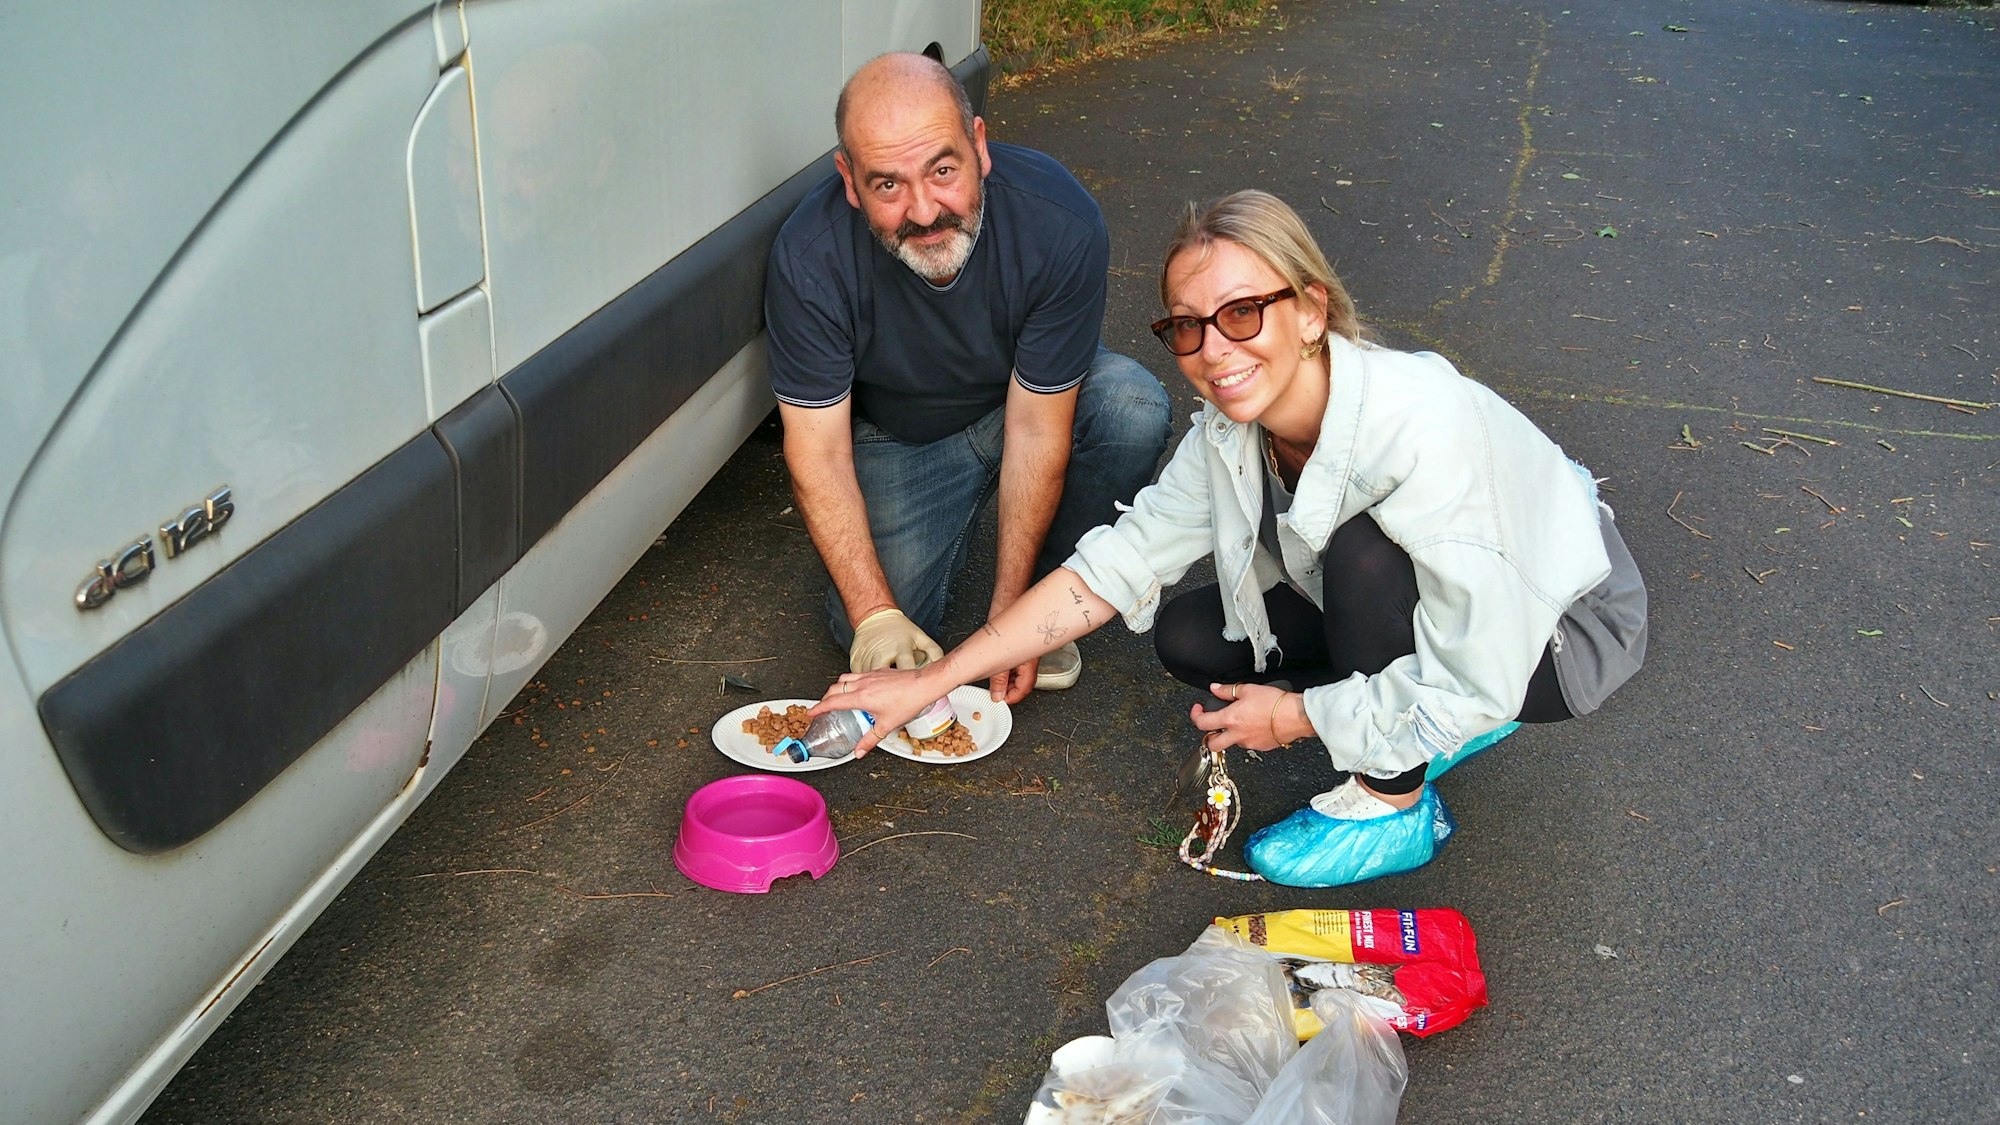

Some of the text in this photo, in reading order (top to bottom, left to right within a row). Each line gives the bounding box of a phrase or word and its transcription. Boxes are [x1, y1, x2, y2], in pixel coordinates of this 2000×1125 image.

[160, 484, 235, 559] 125
[1361, 911, 1375, 949] FINEST MIX
